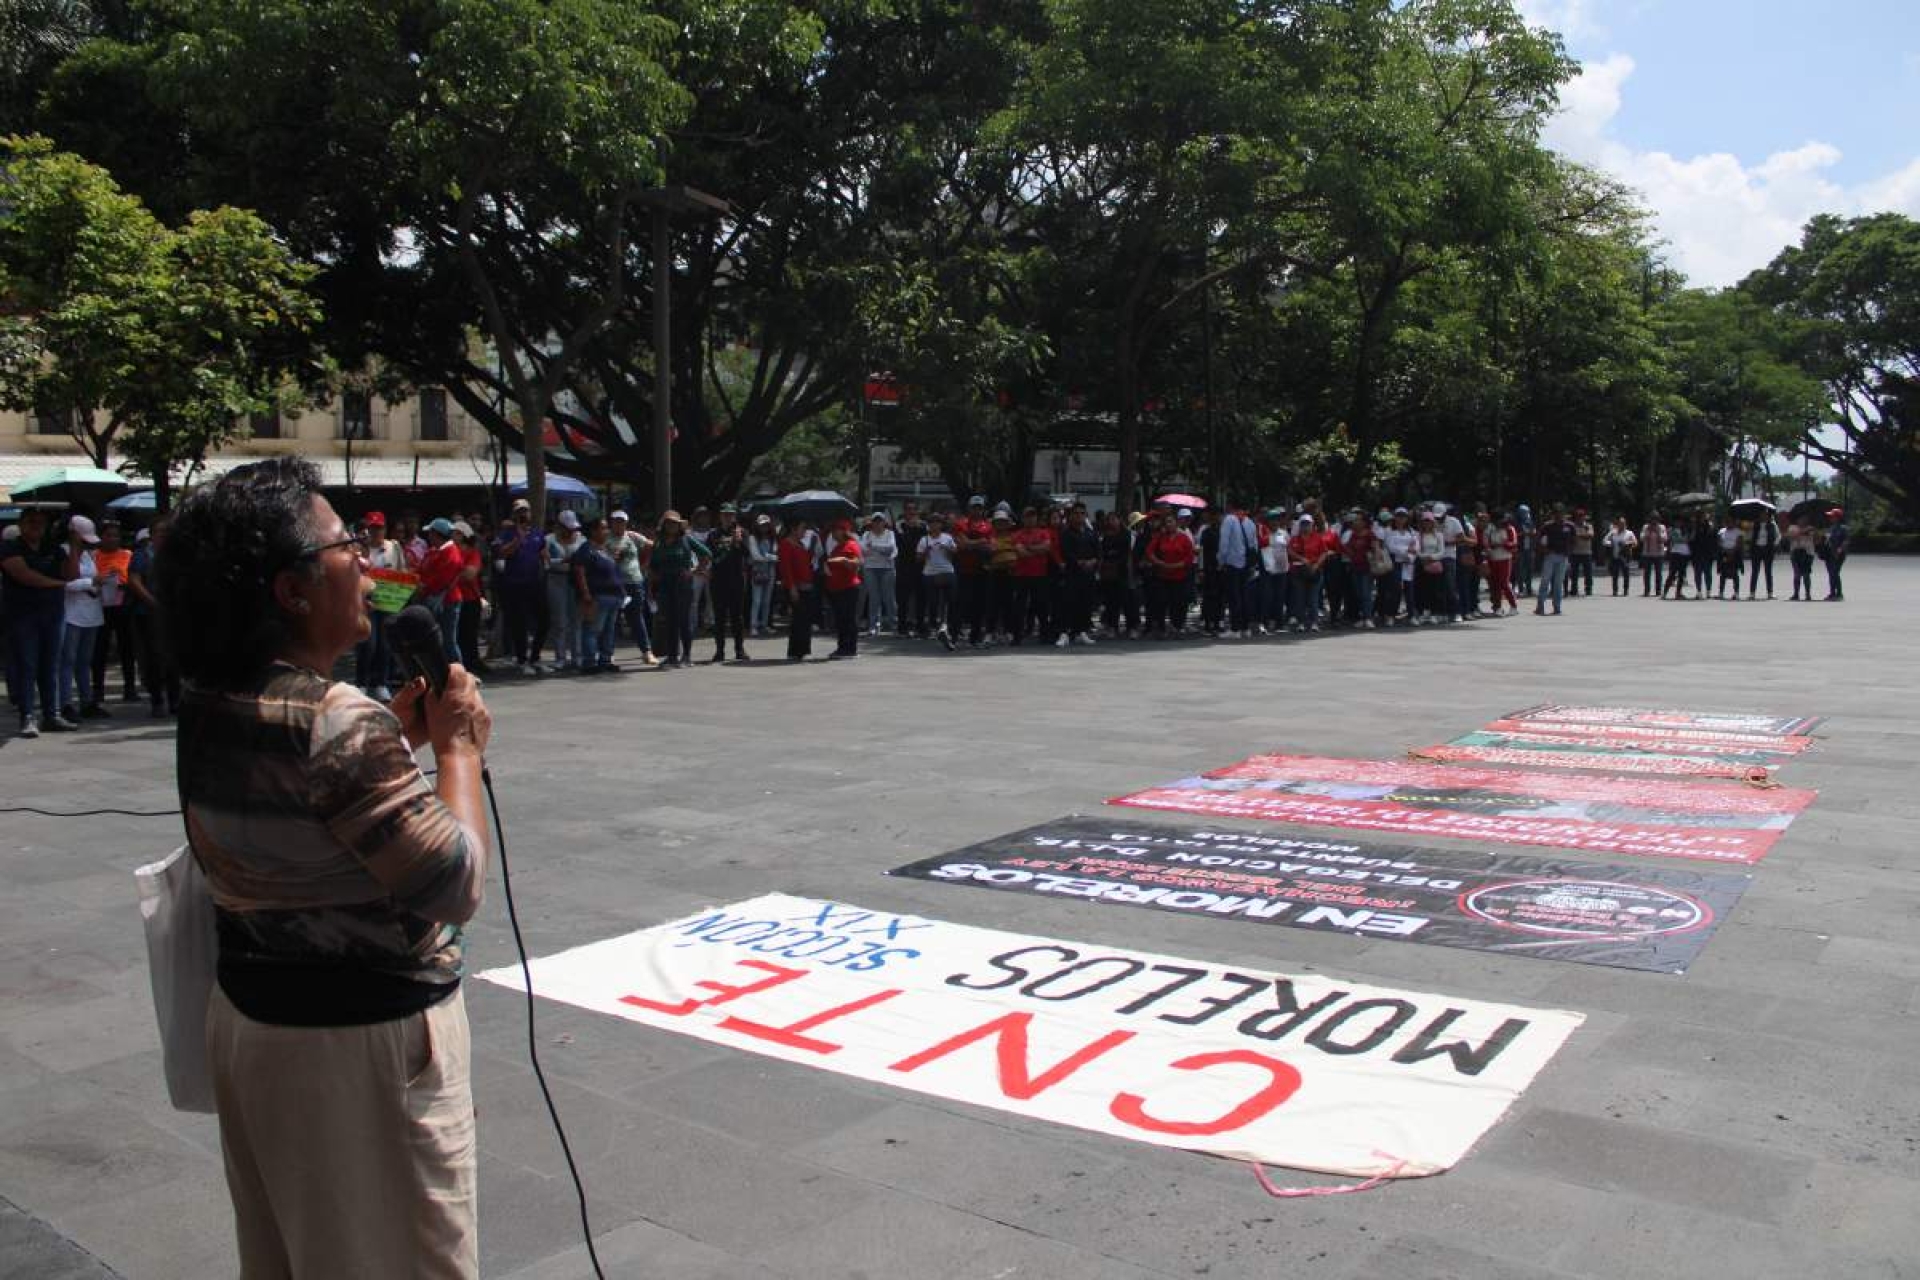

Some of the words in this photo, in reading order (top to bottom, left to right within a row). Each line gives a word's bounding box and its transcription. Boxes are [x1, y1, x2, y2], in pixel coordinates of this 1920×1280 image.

[1192, 832, 1360, 852] MORELOS
[1271, 849, 1415, 869] PUENTE
[930, 863, 1292, 920] MORELOS
[788, 903, 934, 940] XIX
[1297, 906, 1430, 935] EN
[945, 945, 1530, 1076] MORELOS
[617, 959, 1303, 1136] CNTE
